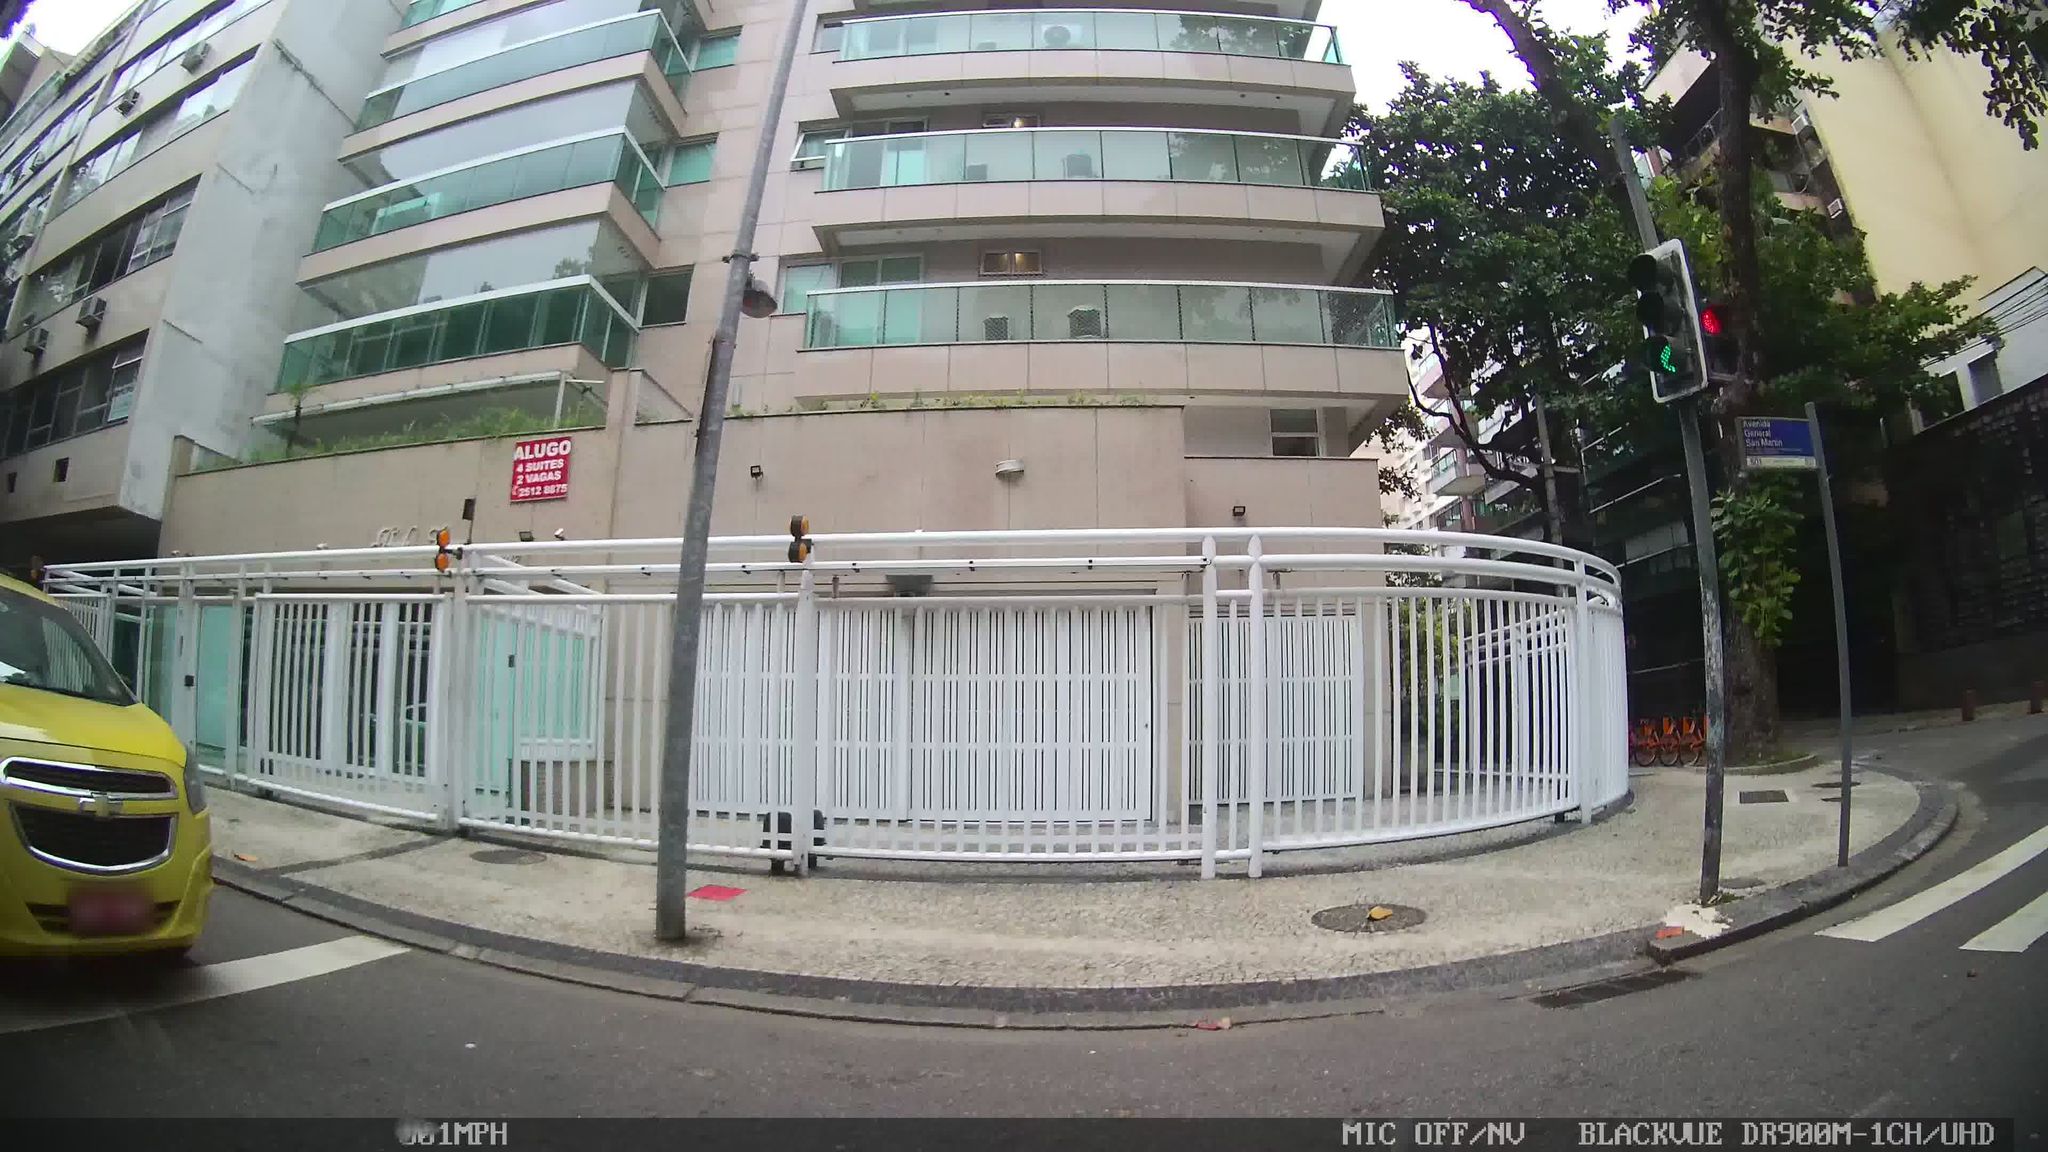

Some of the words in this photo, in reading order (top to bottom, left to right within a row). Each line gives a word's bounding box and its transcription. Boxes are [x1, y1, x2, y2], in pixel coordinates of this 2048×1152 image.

[1743, 420, 1771, 428] Avenida
[1744, 430, 1772, 438] General
[1745, 439, 1760, 448] San
[513, 439, 572, 461] ALUGO
[516, 463, 524, 473] 4
[516, 474, 524, 485] 2
[525, 470, 561, 483] VAGAS
[518, 486, 542, 497] 2512
[543, 483, 568, 495] 8875
